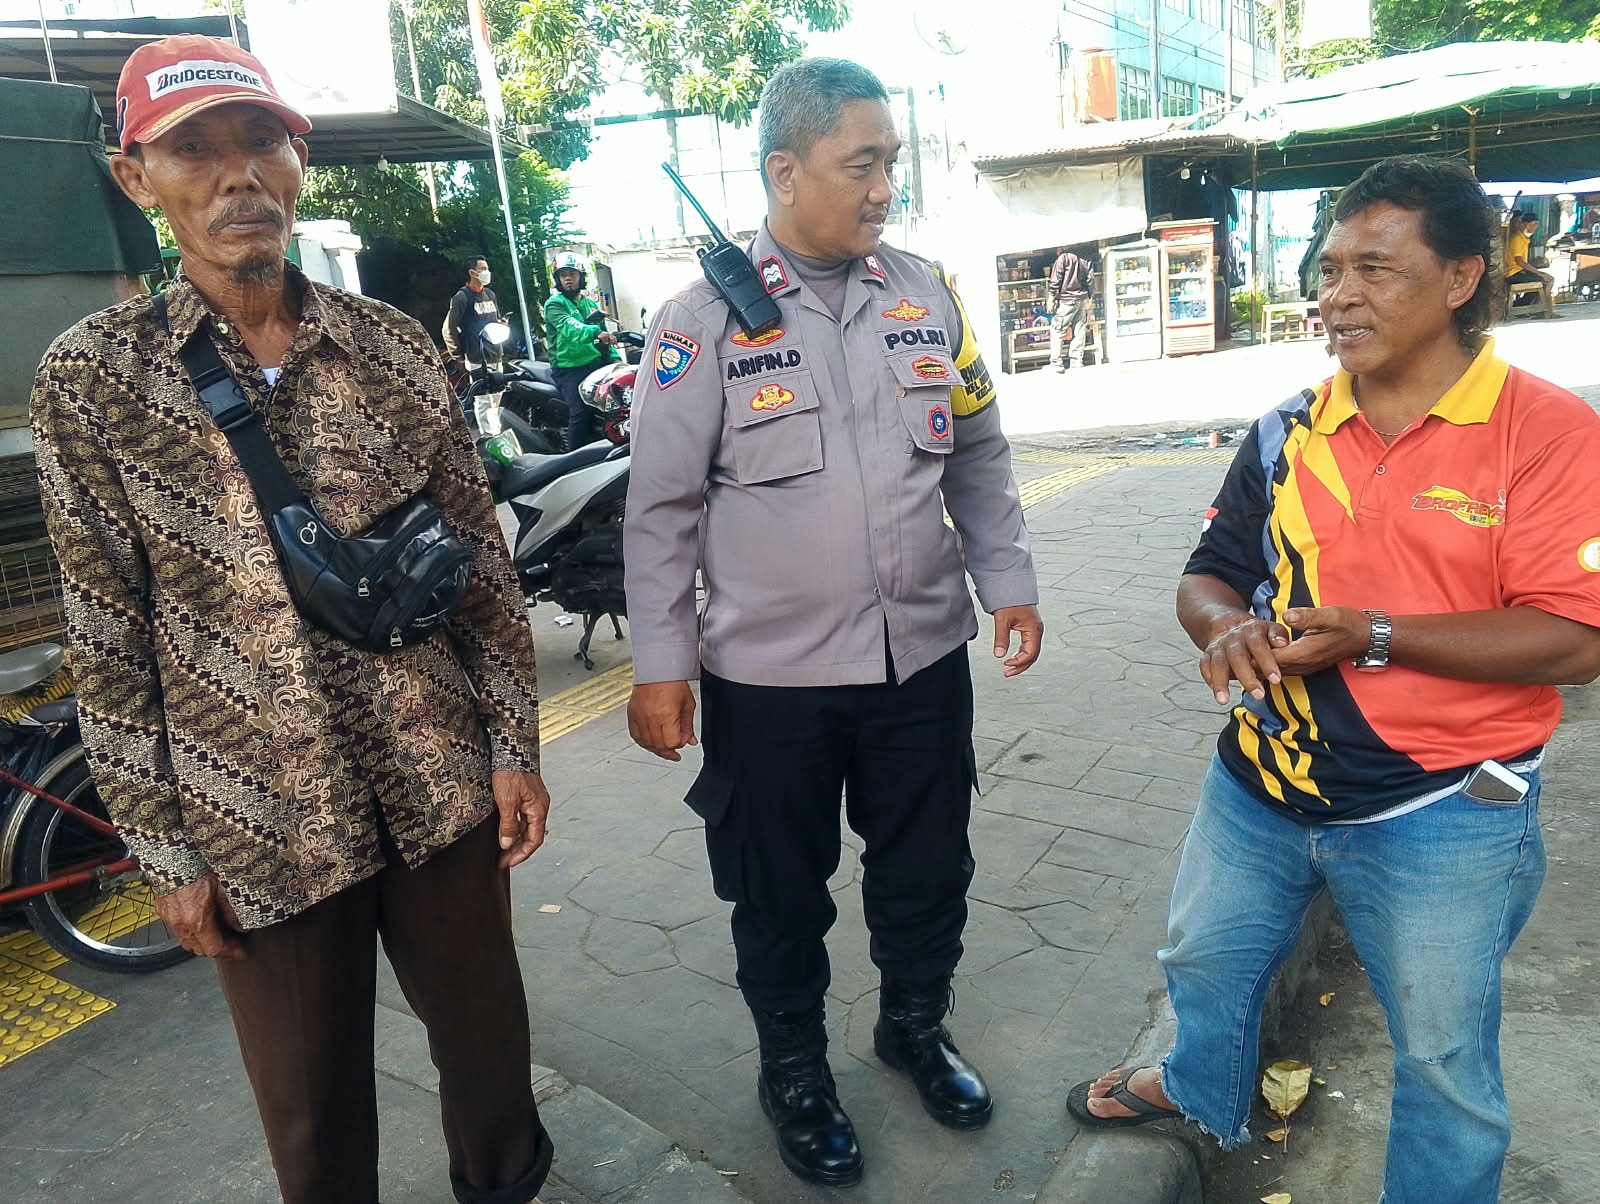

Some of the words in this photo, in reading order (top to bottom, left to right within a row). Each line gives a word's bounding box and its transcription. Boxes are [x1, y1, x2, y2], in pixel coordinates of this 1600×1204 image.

[156, 69, 262, 92] BRIDGESTONE
[662, 331, 695, 350] BINMAS
[884, 328, 947, 350] POLRI
[727, 349, 801, 381] ARIFIN.D
